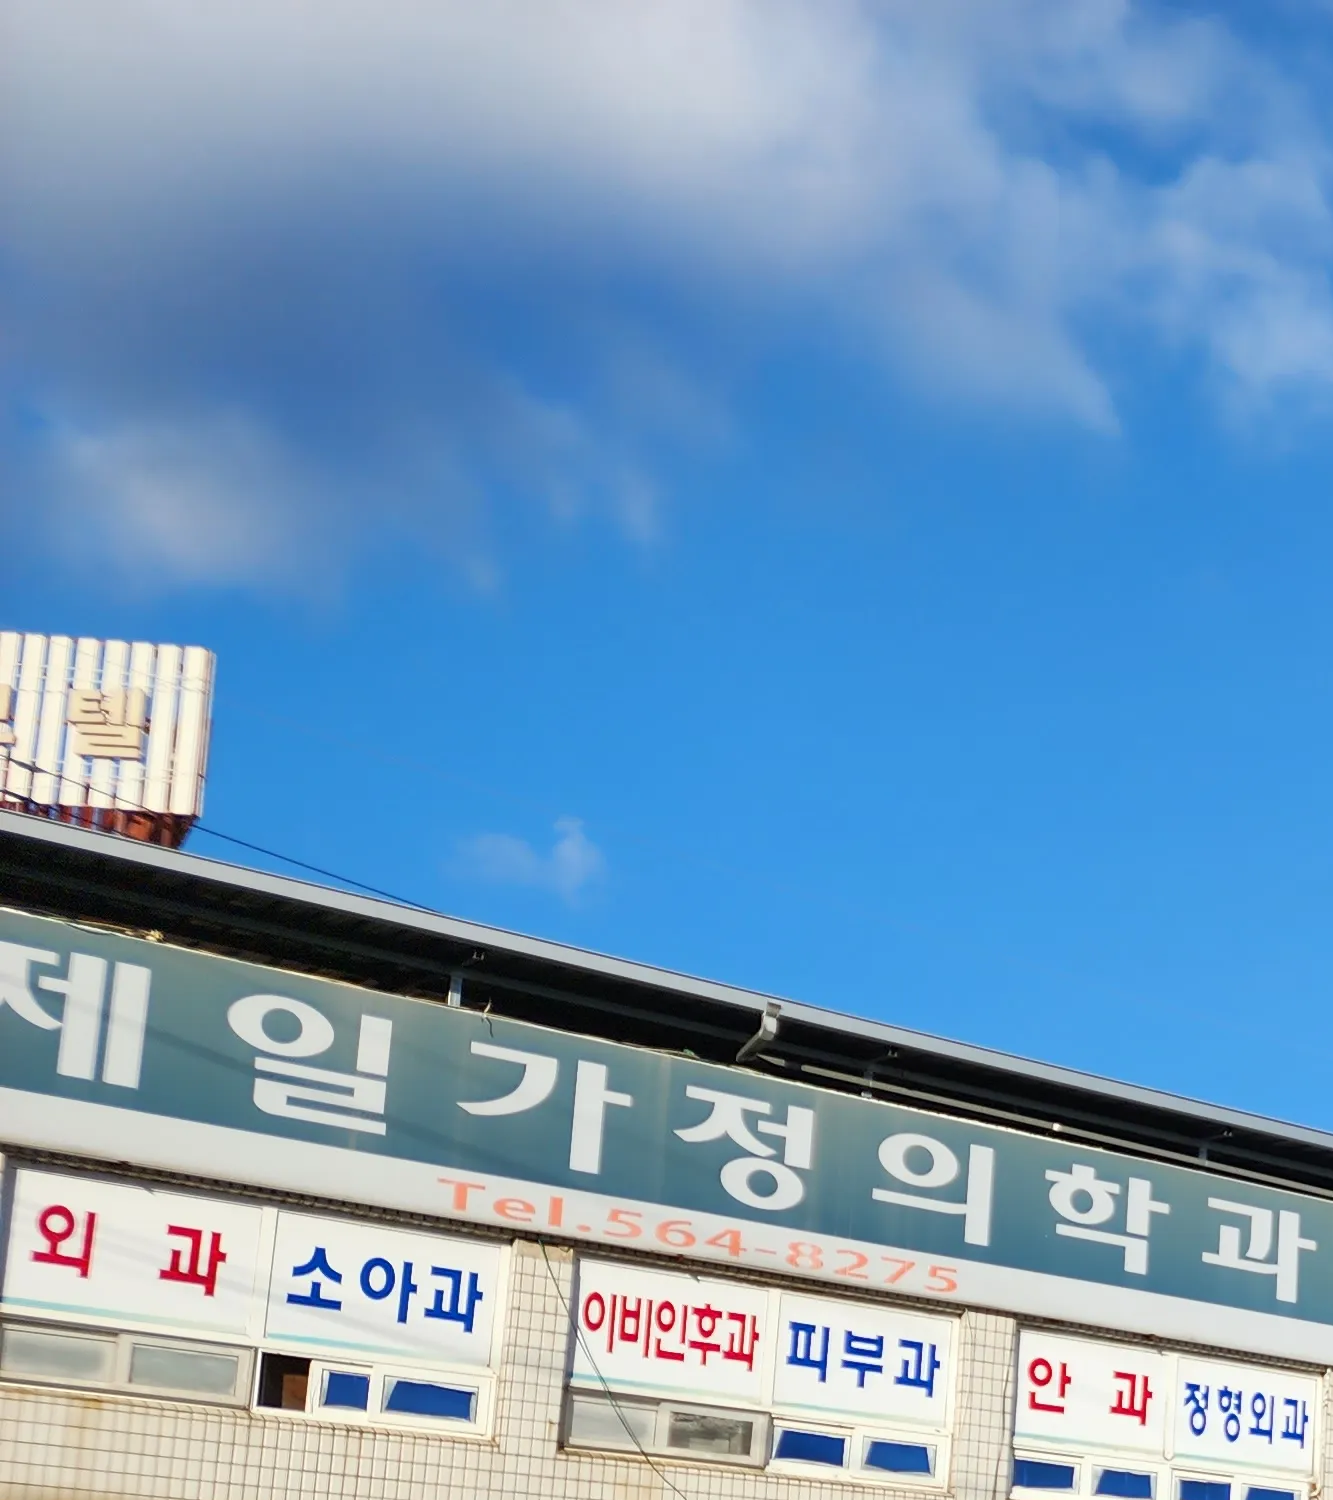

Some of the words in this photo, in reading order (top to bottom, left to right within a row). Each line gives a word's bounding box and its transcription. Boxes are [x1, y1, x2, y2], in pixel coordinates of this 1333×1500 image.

[437, 1177, 961, 1296] Tel.564-8275
[286, 1246, 484, 1334] 소아과
[582, 1289, 761, 1372] 이비인후과
[786, 1320, 942, 1399] 피부과
[1183, 1381, 1310, 1451] 정형외과
